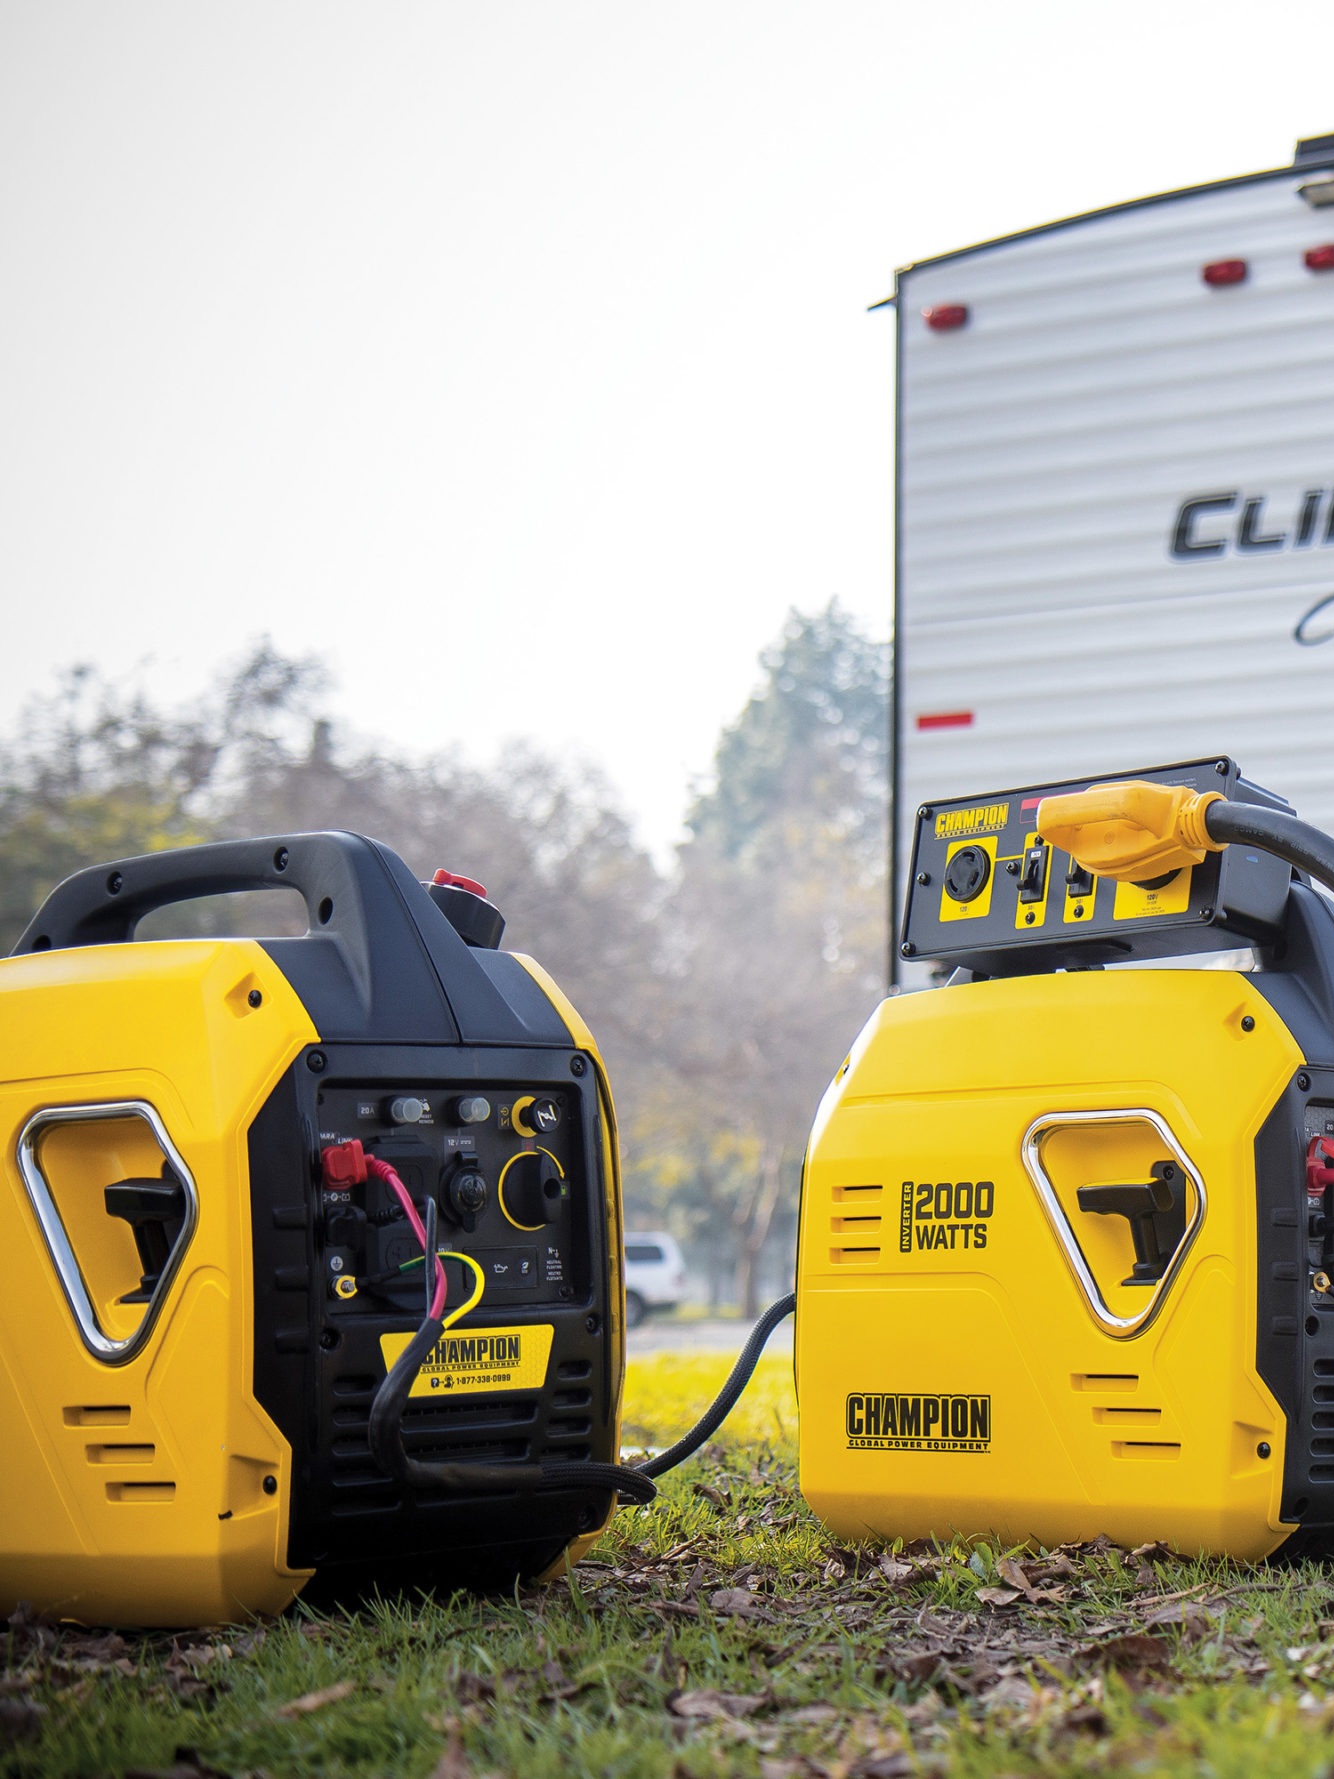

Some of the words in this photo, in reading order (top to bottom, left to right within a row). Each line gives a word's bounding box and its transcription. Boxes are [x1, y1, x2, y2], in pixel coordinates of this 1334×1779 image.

[936, 803, 1009, 834] CHAMPION
[915, 1181, 995, 1220] 2000
[902, 1184, 912, 1249] INVERTER
[915, 1223, 988, 1250] WATTS
[452, 1363, 477, 1371] POWER
[479, 1361, 520, 1370] EQUIPMENT
[847, 1393, 990, 1441] CHAMPION
[888, 1440, 922, 1448] POWER
[927, 1442, 989, 1450] EQUIPMENT
